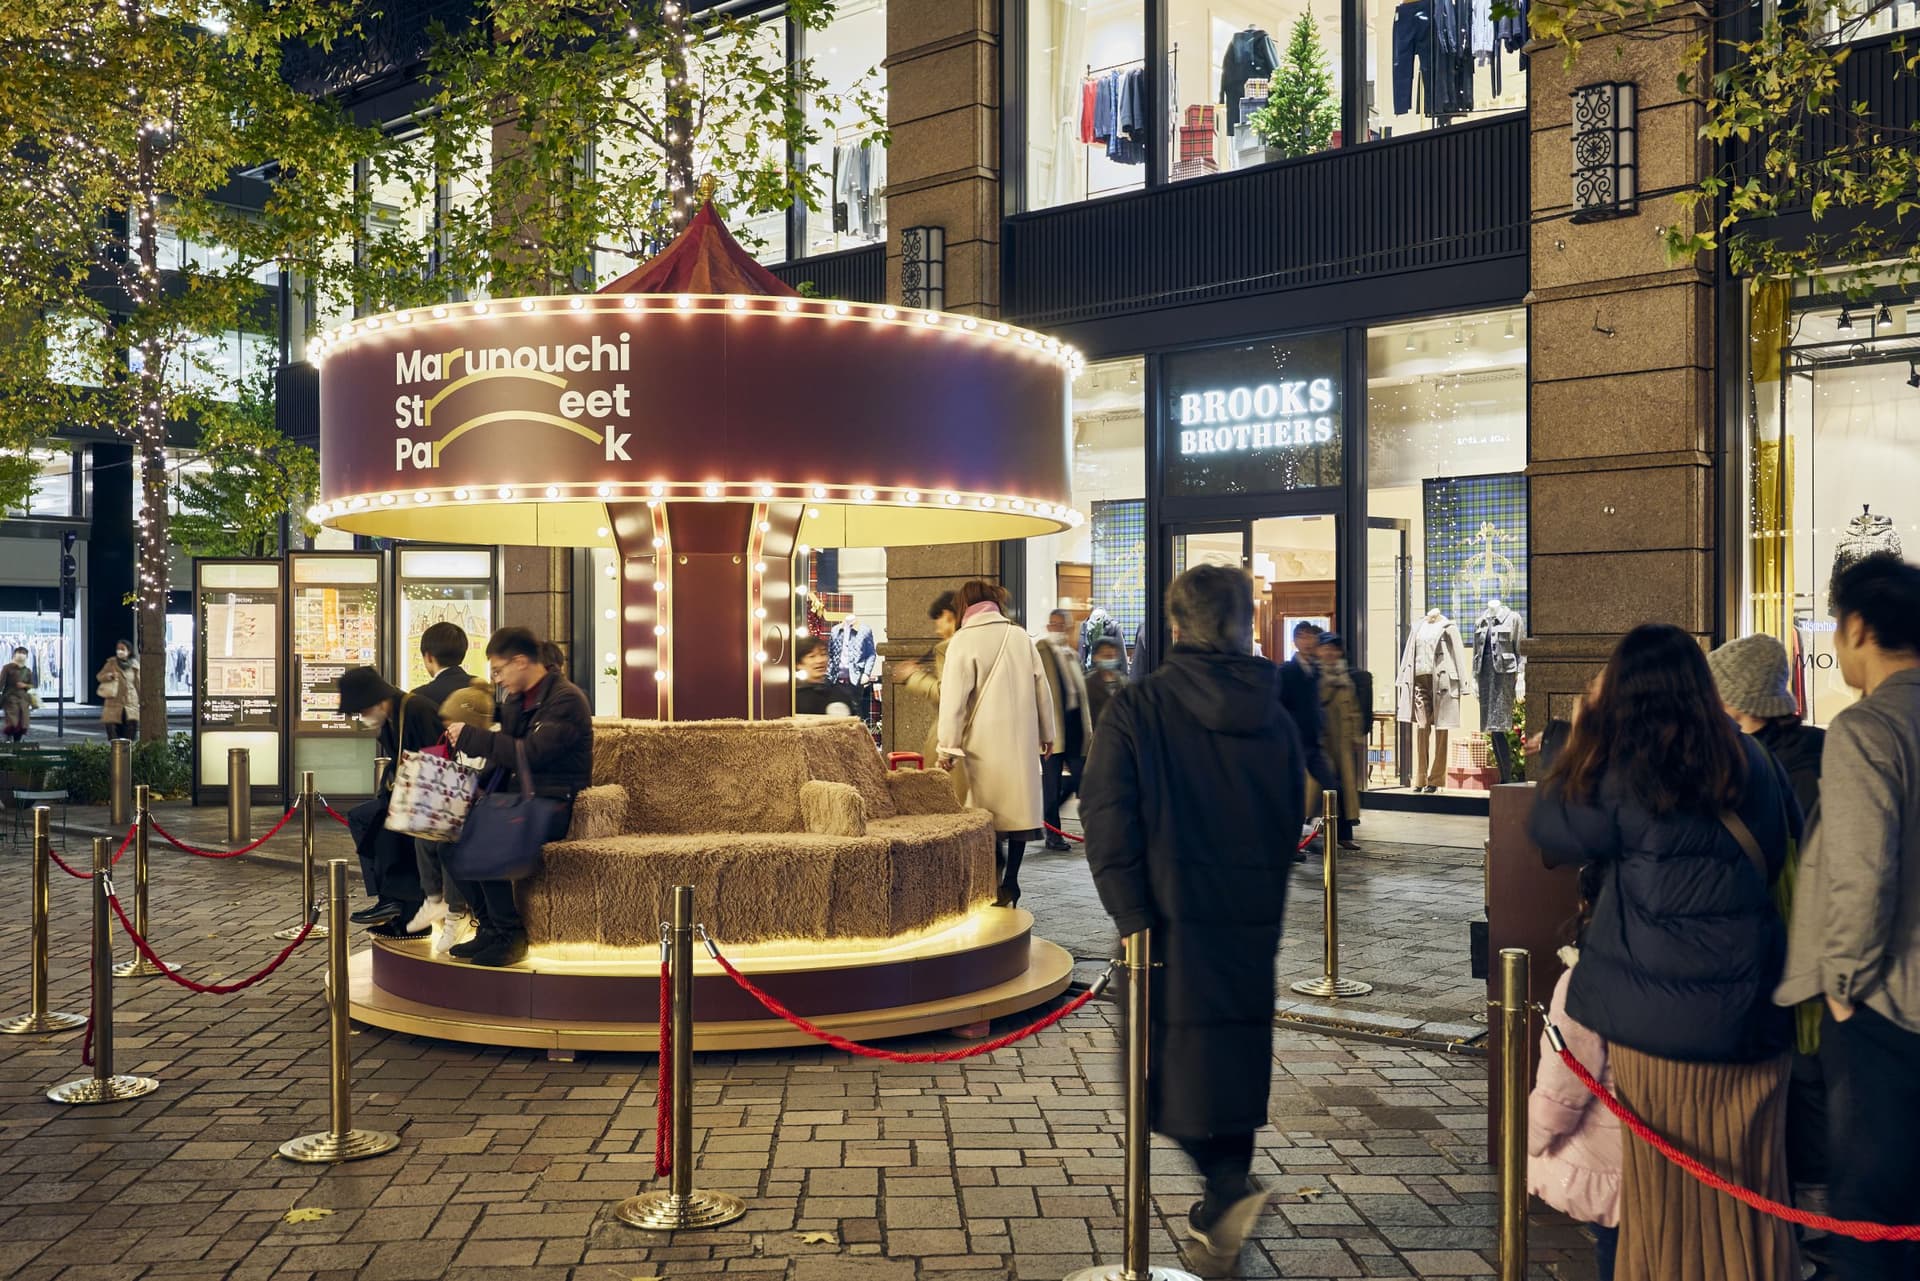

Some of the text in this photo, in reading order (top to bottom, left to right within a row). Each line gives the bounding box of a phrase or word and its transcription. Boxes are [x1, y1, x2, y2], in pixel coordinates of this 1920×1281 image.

[396, 332, 630, 385] Marunouchi
[1180, 378, 1333, 426] BROOKS
[1181, 417, 1332, 454] BROTHERS
[1796, 653, 1839, 669] MO
